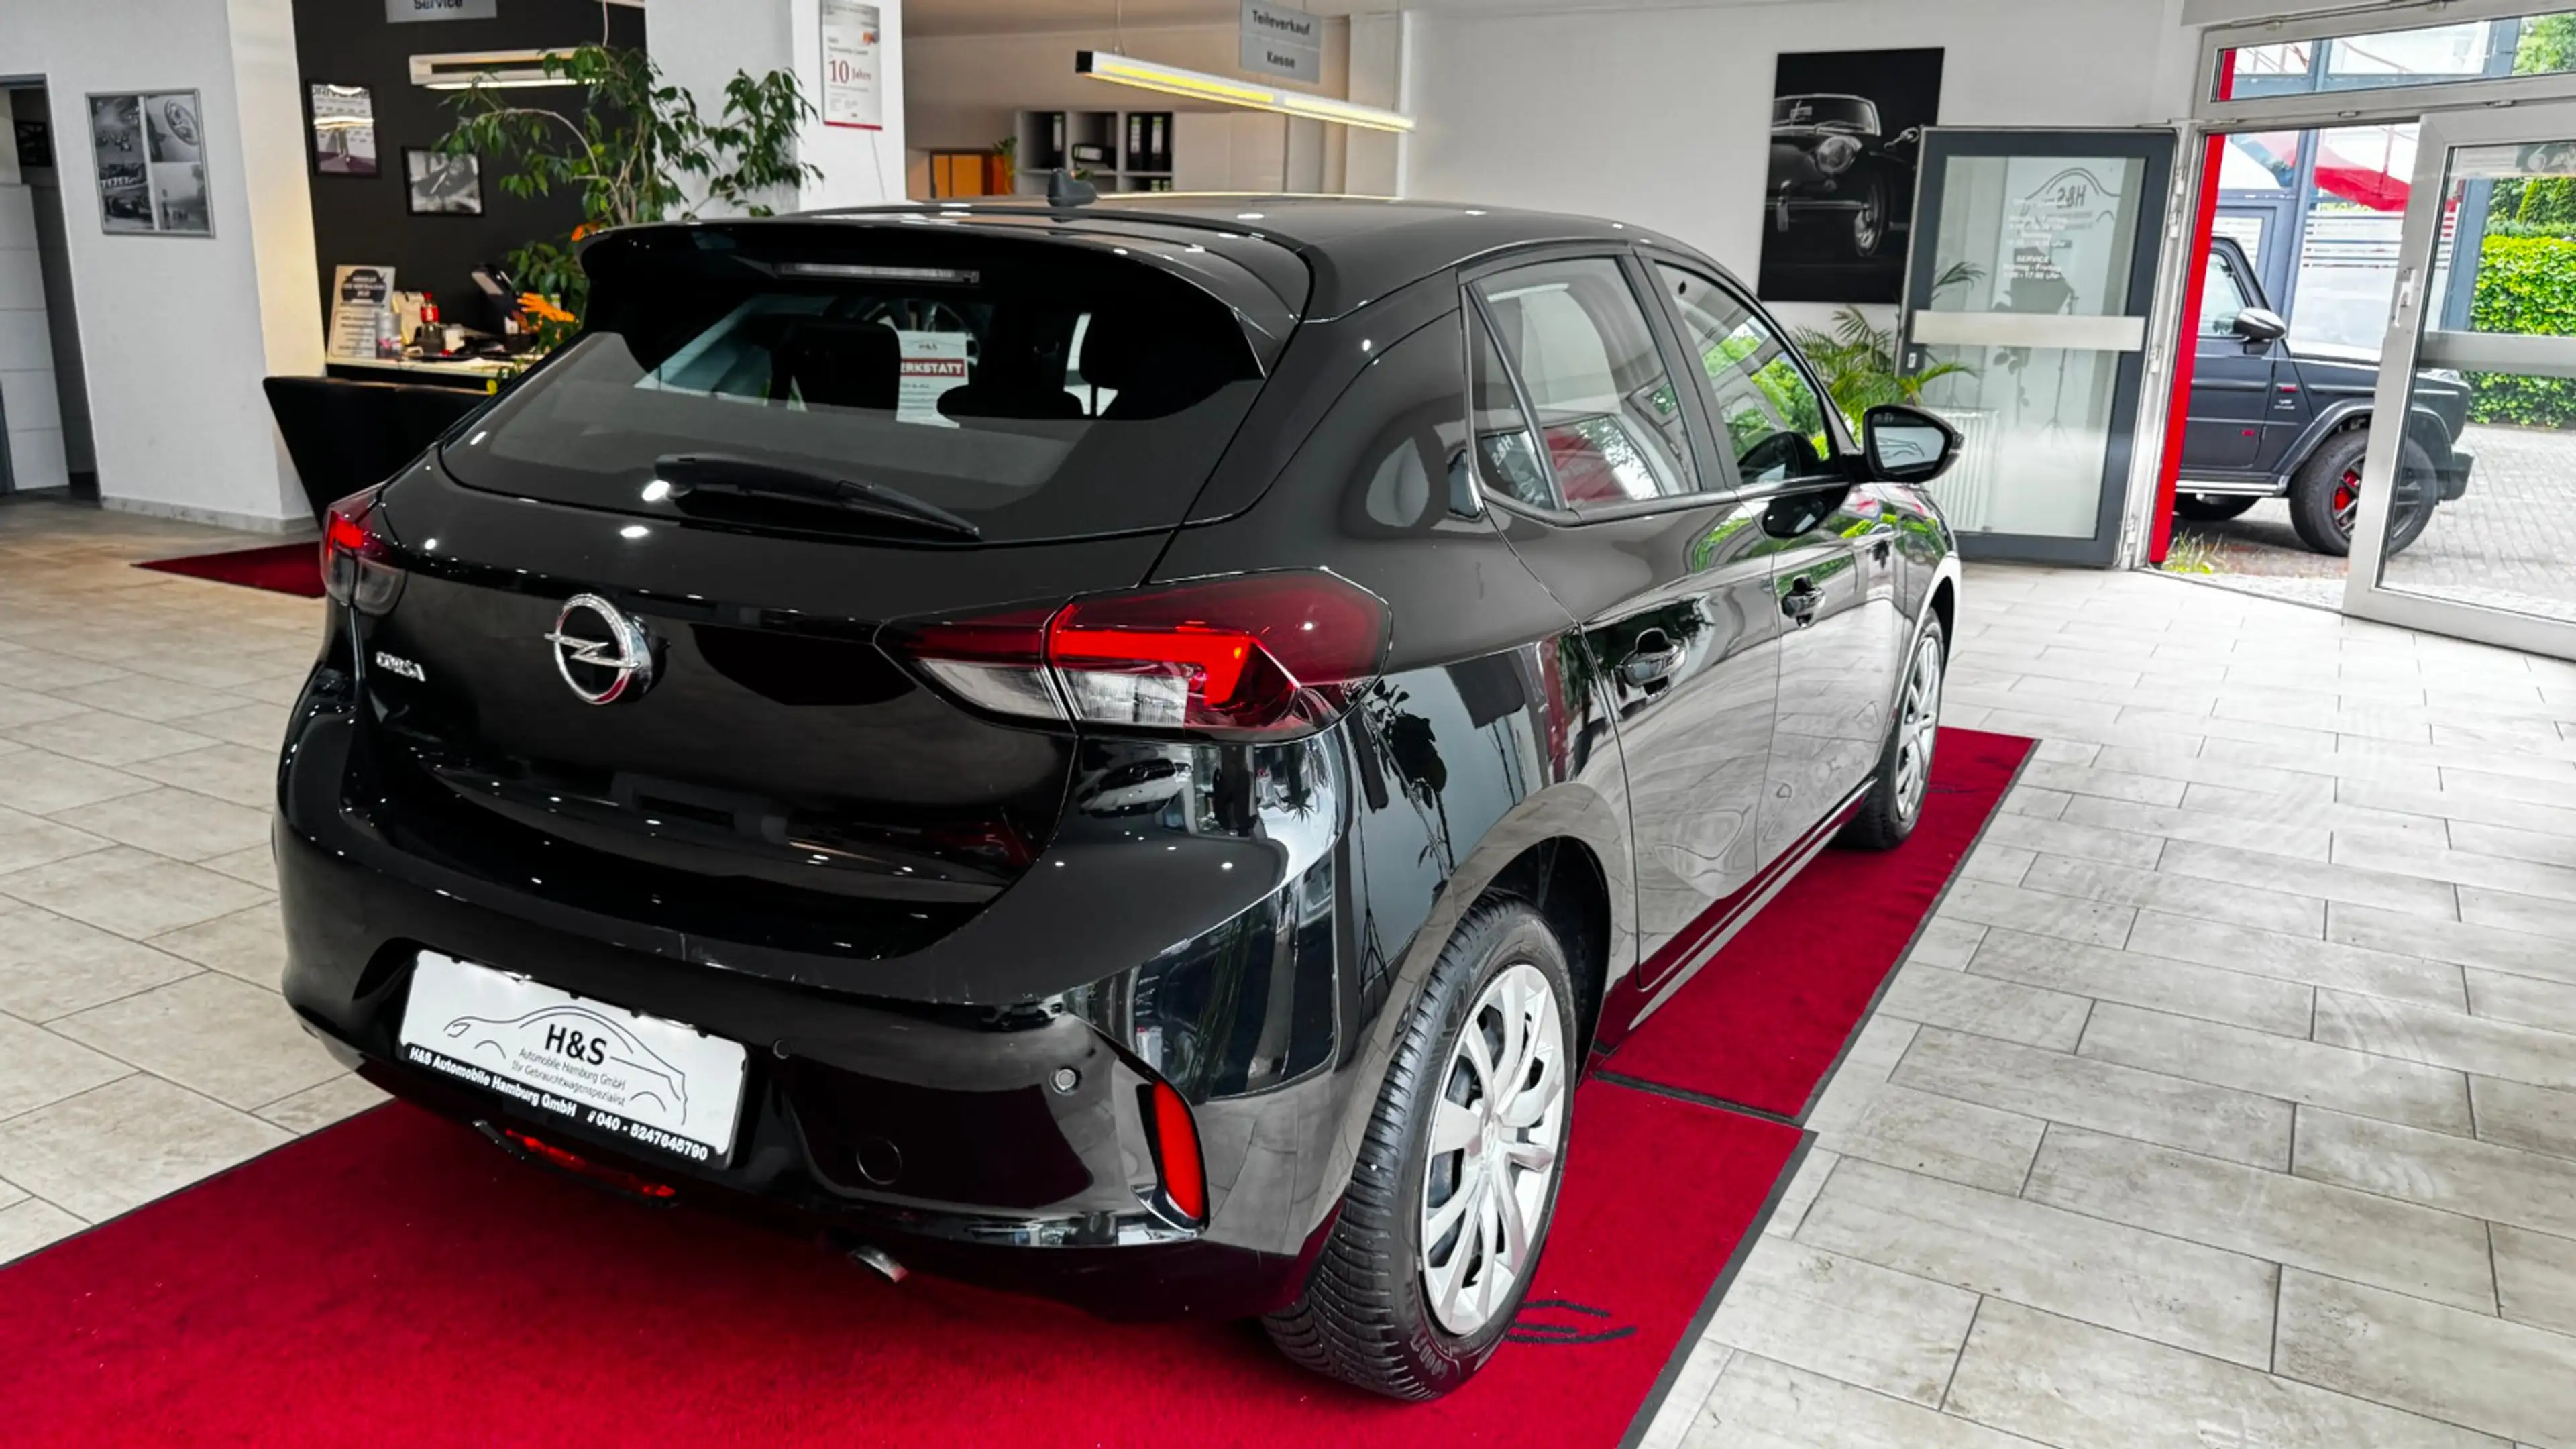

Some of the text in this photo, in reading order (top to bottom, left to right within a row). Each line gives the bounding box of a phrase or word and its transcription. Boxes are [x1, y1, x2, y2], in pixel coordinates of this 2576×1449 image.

[1252, 9, 1310, 36] Teileverkauf
[829, 59, 849, 83] 10
[1267, 50, 1295, 69] Kasse
[900, 362, 963, 374] ERKSTATT
[545, 1023, 608, 1066] H&S
[519, 1046, 626, 1091] Automobile Hamburg GmbH
[409, 1046, 433, 1065] H&S
[432, 1054, 490, 1086] Automobile
[491, 1075, 539, 1107] Hamburg
[541, 1093, 577, 1117] GmbH
[596, 1113, 621, 1132] 040
